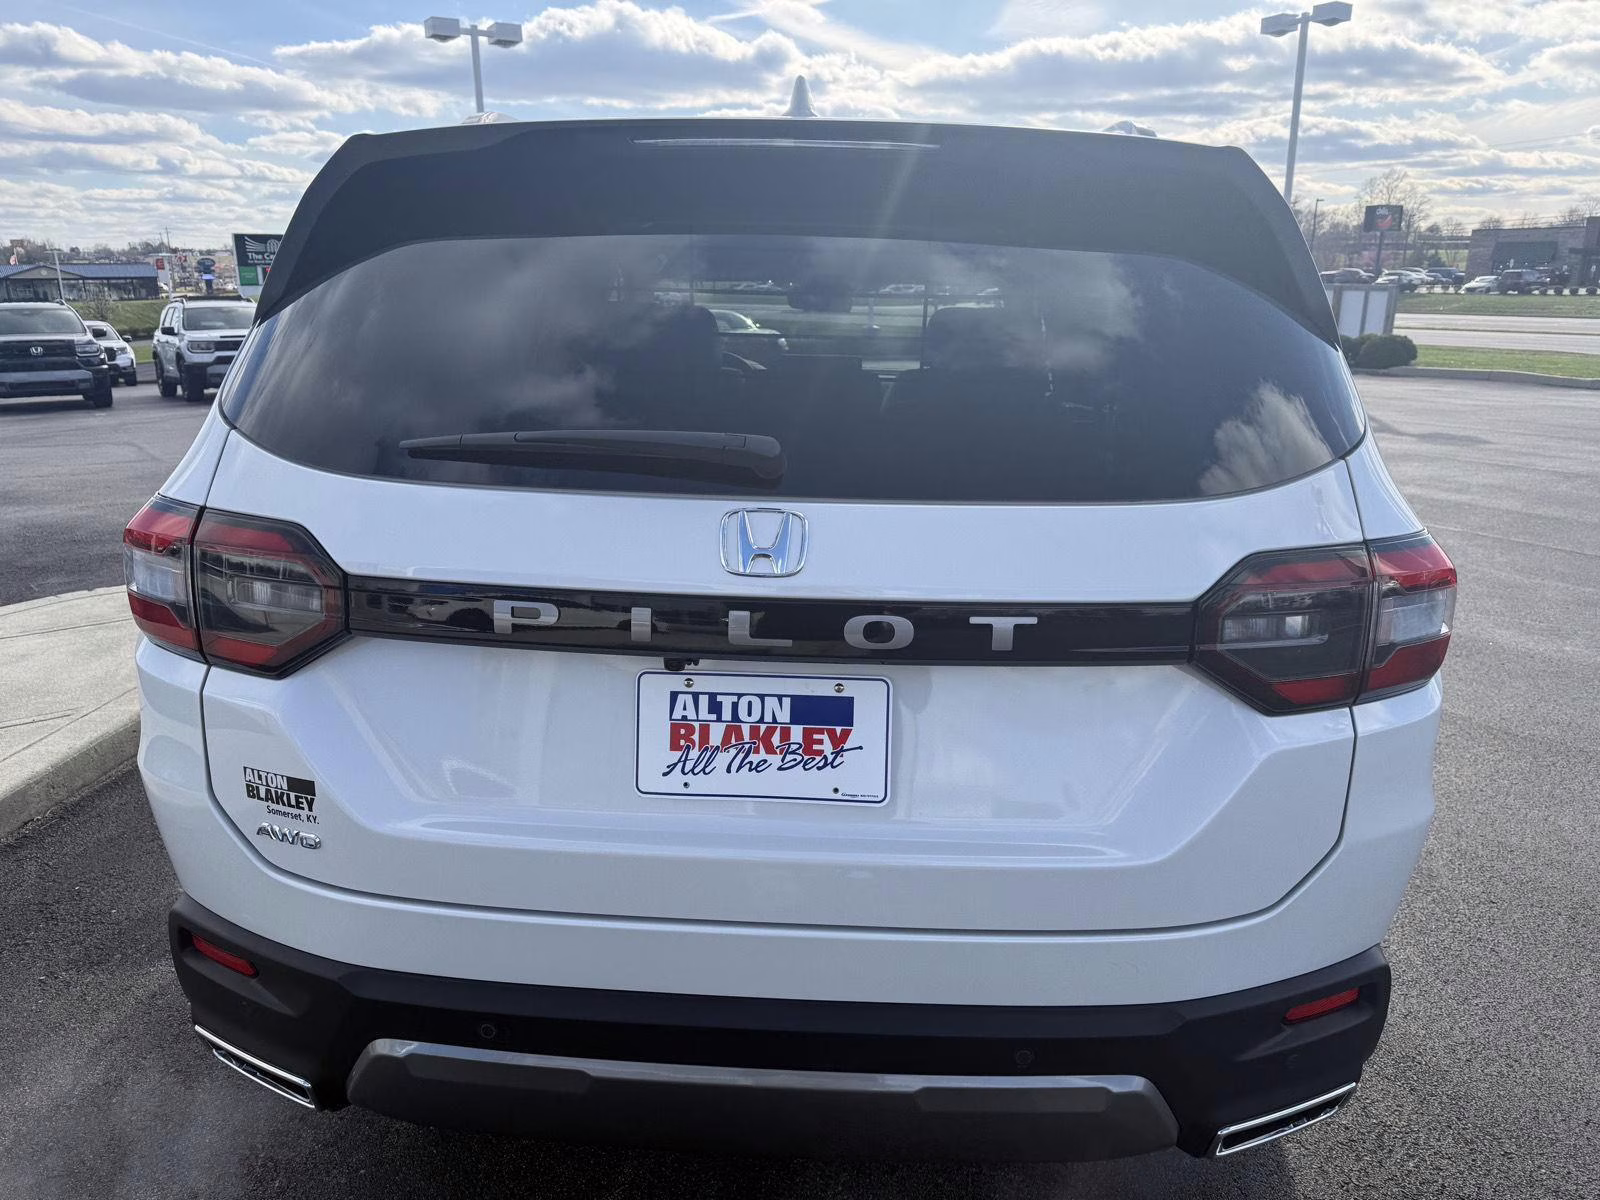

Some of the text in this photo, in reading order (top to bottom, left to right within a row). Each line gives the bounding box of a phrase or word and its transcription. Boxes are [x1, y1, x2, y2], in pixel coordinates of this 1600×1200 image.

[493, 600, 1038, 651] PILOT
[671, 693, 791, 724] ALTON
[669, 722, 853, 757] BLAKLEY
[662, 740, 864, 777] All The Best
[245, 768, 288, 791] ALTON
[245, 783, 316, 812] BLAKLEY
[266, 805, 320, 825] Somerset, KY.
[256, 821, 322, 850] AWD
